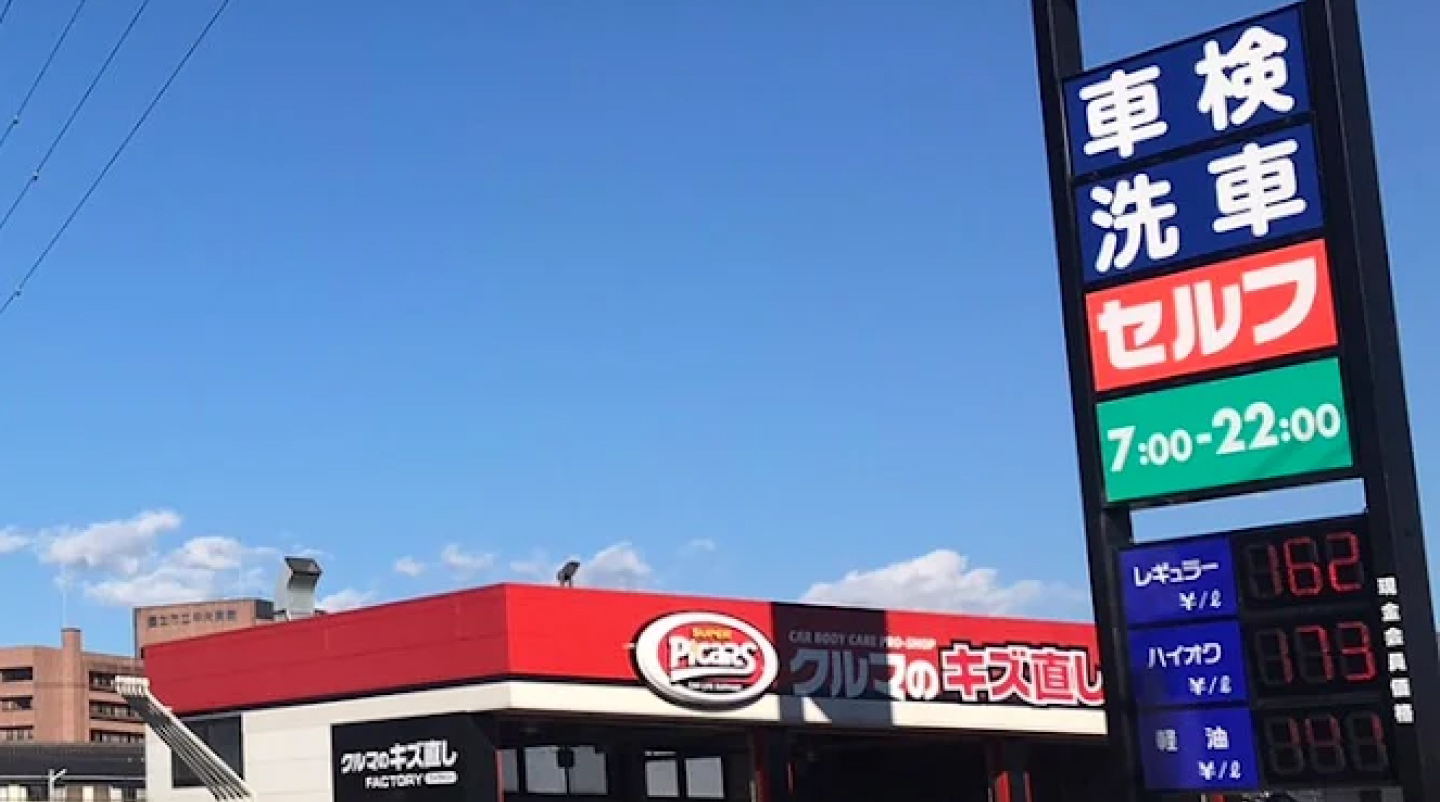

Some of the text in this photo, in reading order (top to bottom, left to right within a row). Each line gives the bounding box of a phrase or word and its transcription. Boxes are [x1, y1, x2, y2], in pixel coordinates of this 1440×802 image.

[1079, 26, 1294, 158] 車検
[1090, 139, 1308, 273] 洗車
[1096, 257, 1317, 370] セルフ
[1107, 402, 1341, 472] 7:00-22:00
[1134, 558, 1219, 587] レギュラー
[1268, 532, 1363, 597] 162
[1148, 642, 1222, 669] ハイオク
[1277, 621, 1377, 684] 173
[364, 772, 423, 789] FACTORY
